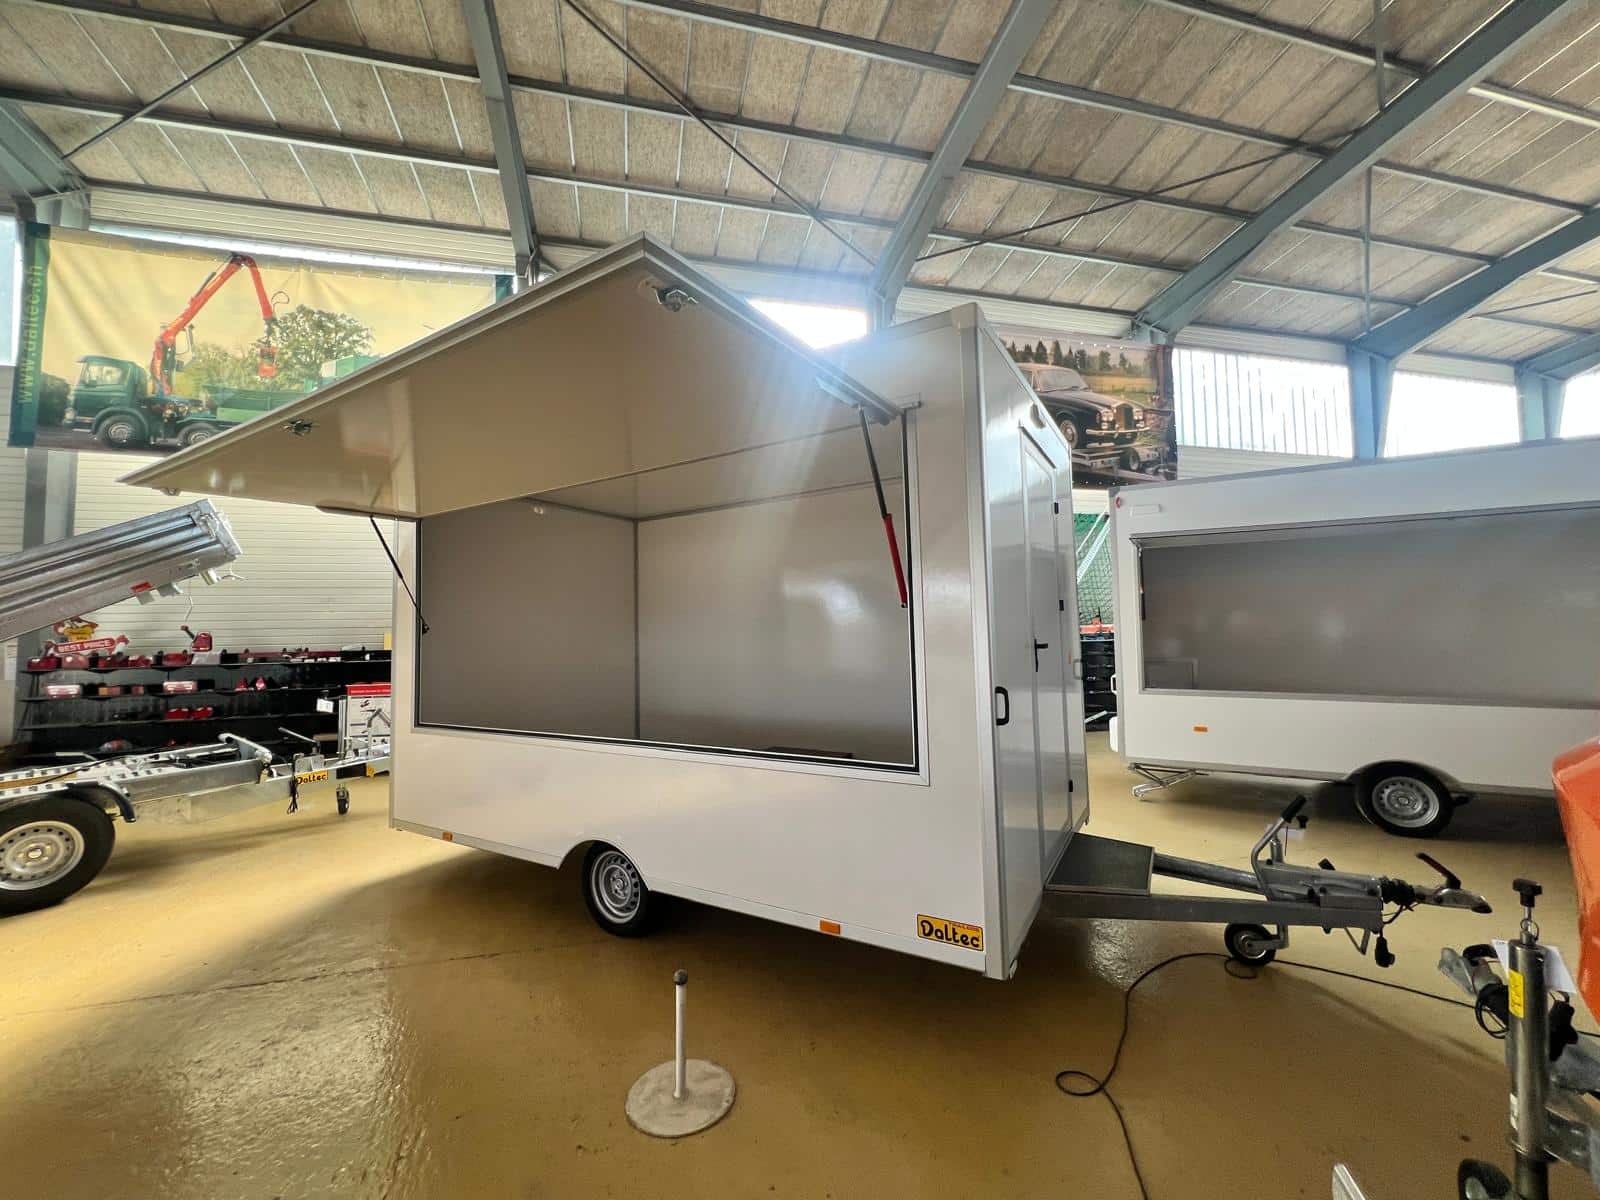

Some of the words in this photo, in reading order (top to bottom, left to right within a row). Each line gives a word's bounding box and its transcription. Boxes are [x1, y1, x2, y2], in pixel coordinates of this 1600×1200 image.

[18, 265, 43, 403] www.daltec.ch
[58, 644, 81, 652] BEST
[296, 774, 326, 784] Daltec
[920, 920, 980, 948] Daltec
